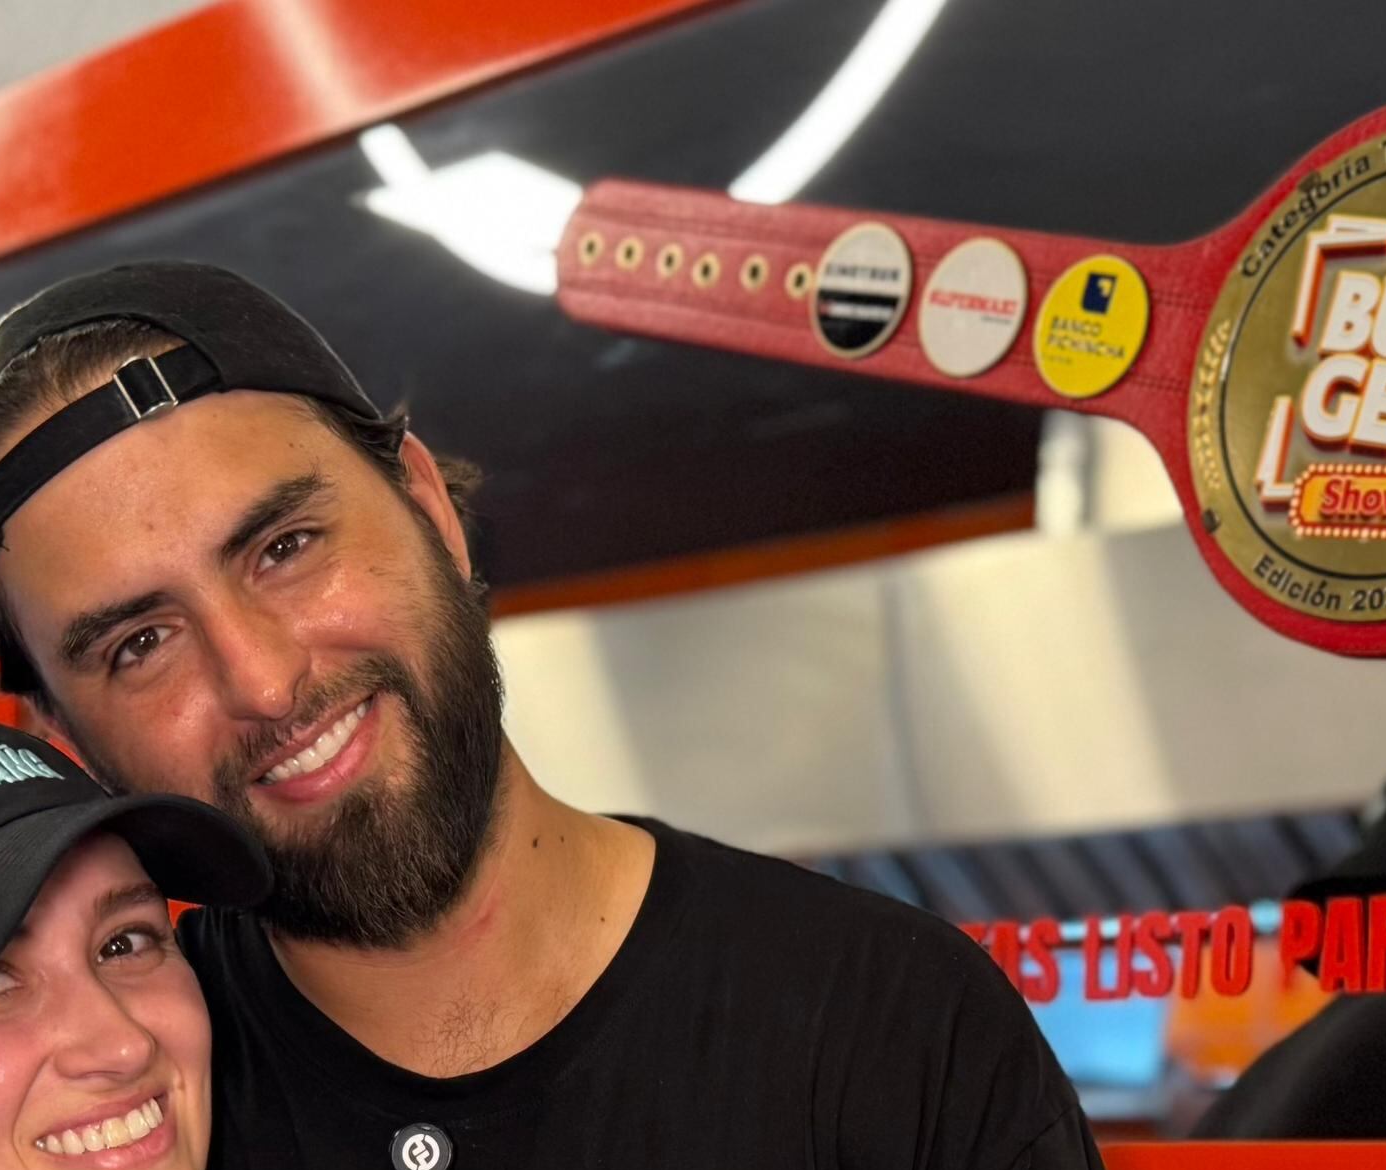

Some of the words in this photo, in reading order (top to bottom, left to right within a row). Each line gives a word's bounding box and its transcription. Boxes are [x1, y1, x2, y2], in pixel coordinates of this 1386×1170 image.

[1051, 316, 1101, 337] BANCO
[1253, 552, 1342, 612] Edición
[1083, 904, 1252, 1002] LISTO
